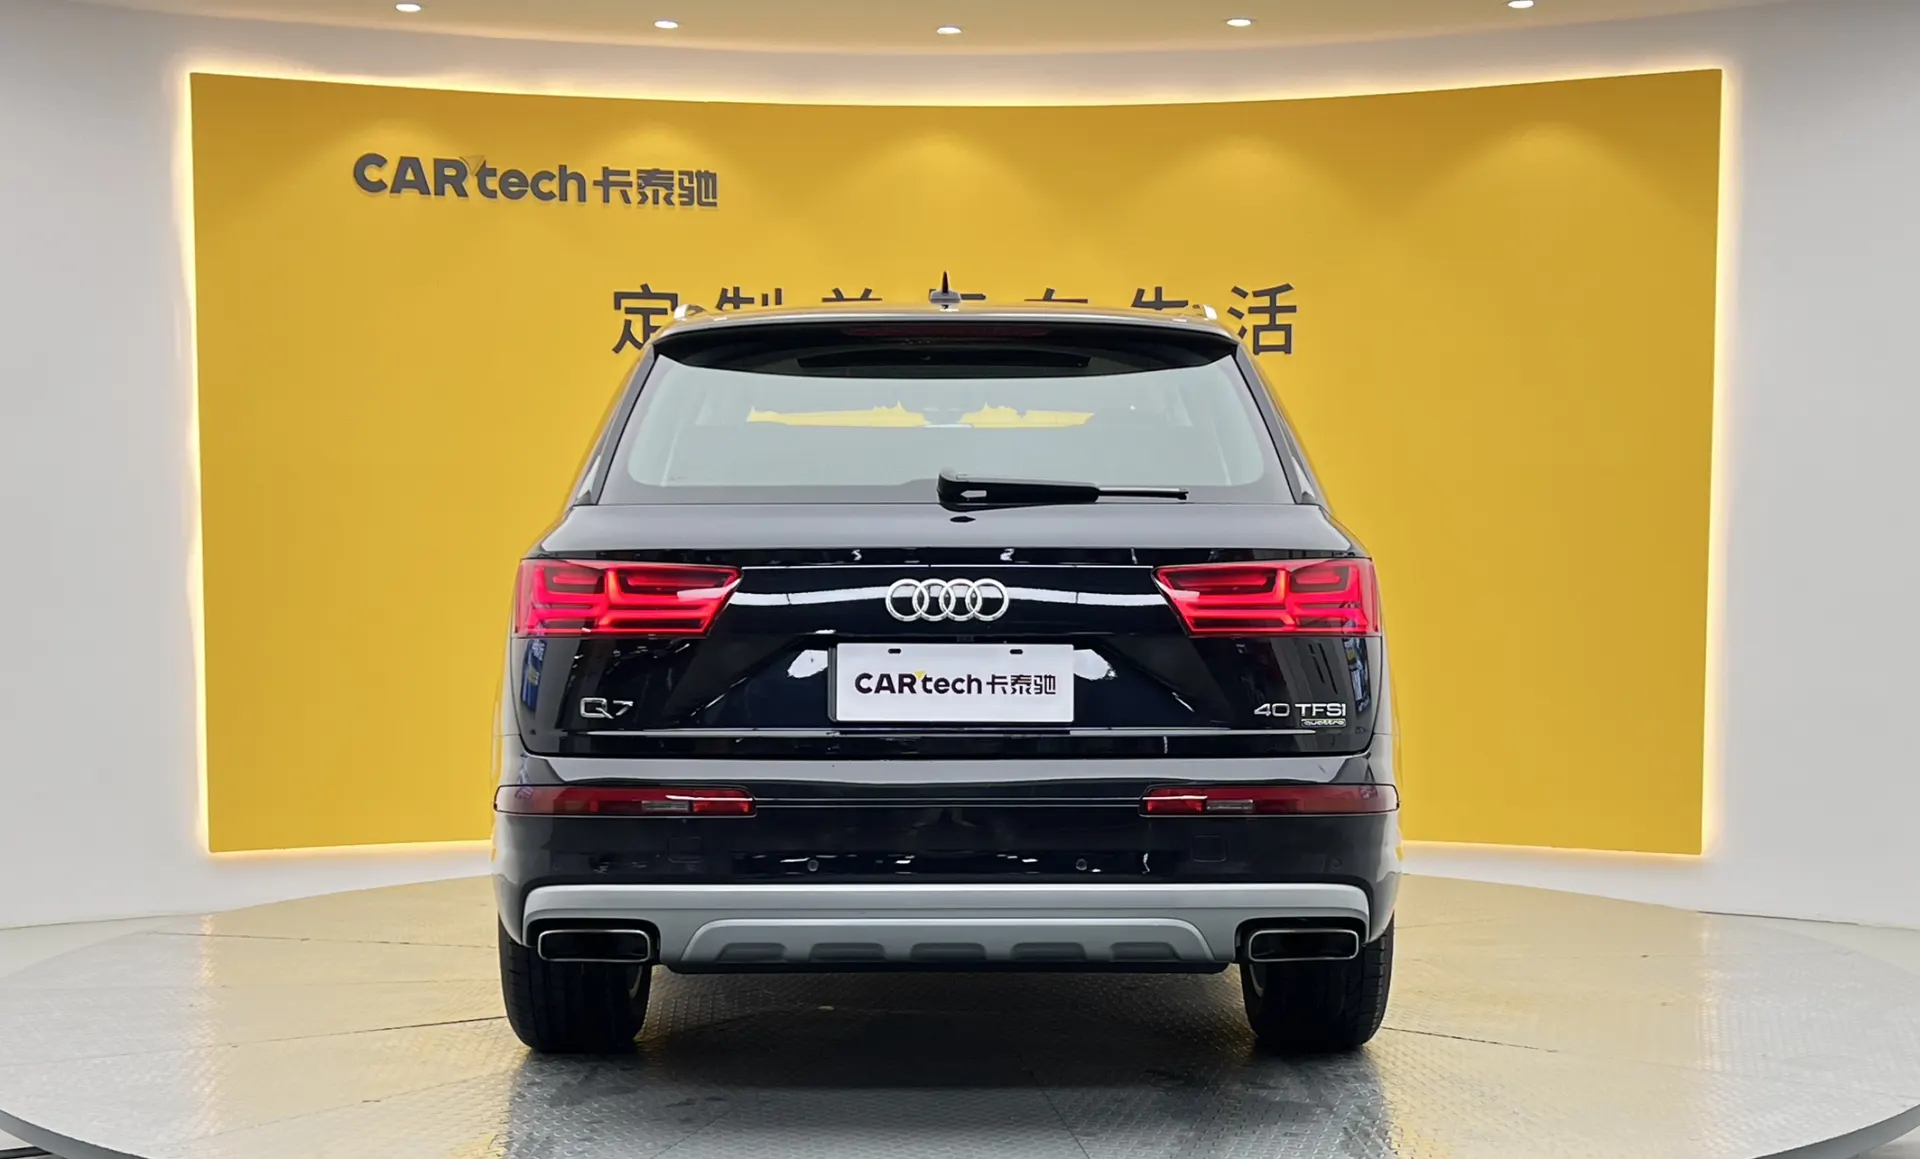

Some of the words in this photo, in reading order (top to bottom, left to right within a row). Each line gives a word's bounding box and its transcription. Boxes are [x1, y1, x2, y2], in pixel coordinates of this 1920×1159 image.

[353, 152, 587, 203] CARtech
[593, 166, 719, 207] 卡泰驰
[854, 672, 983, 695] CARtech
[986, 673, 1057, 695] 卡泰驰
[579, 697, 634, 719] Q7
[1253, 703, 1290, 717] 40
[1294, 703, 1347, 717] TFSI
